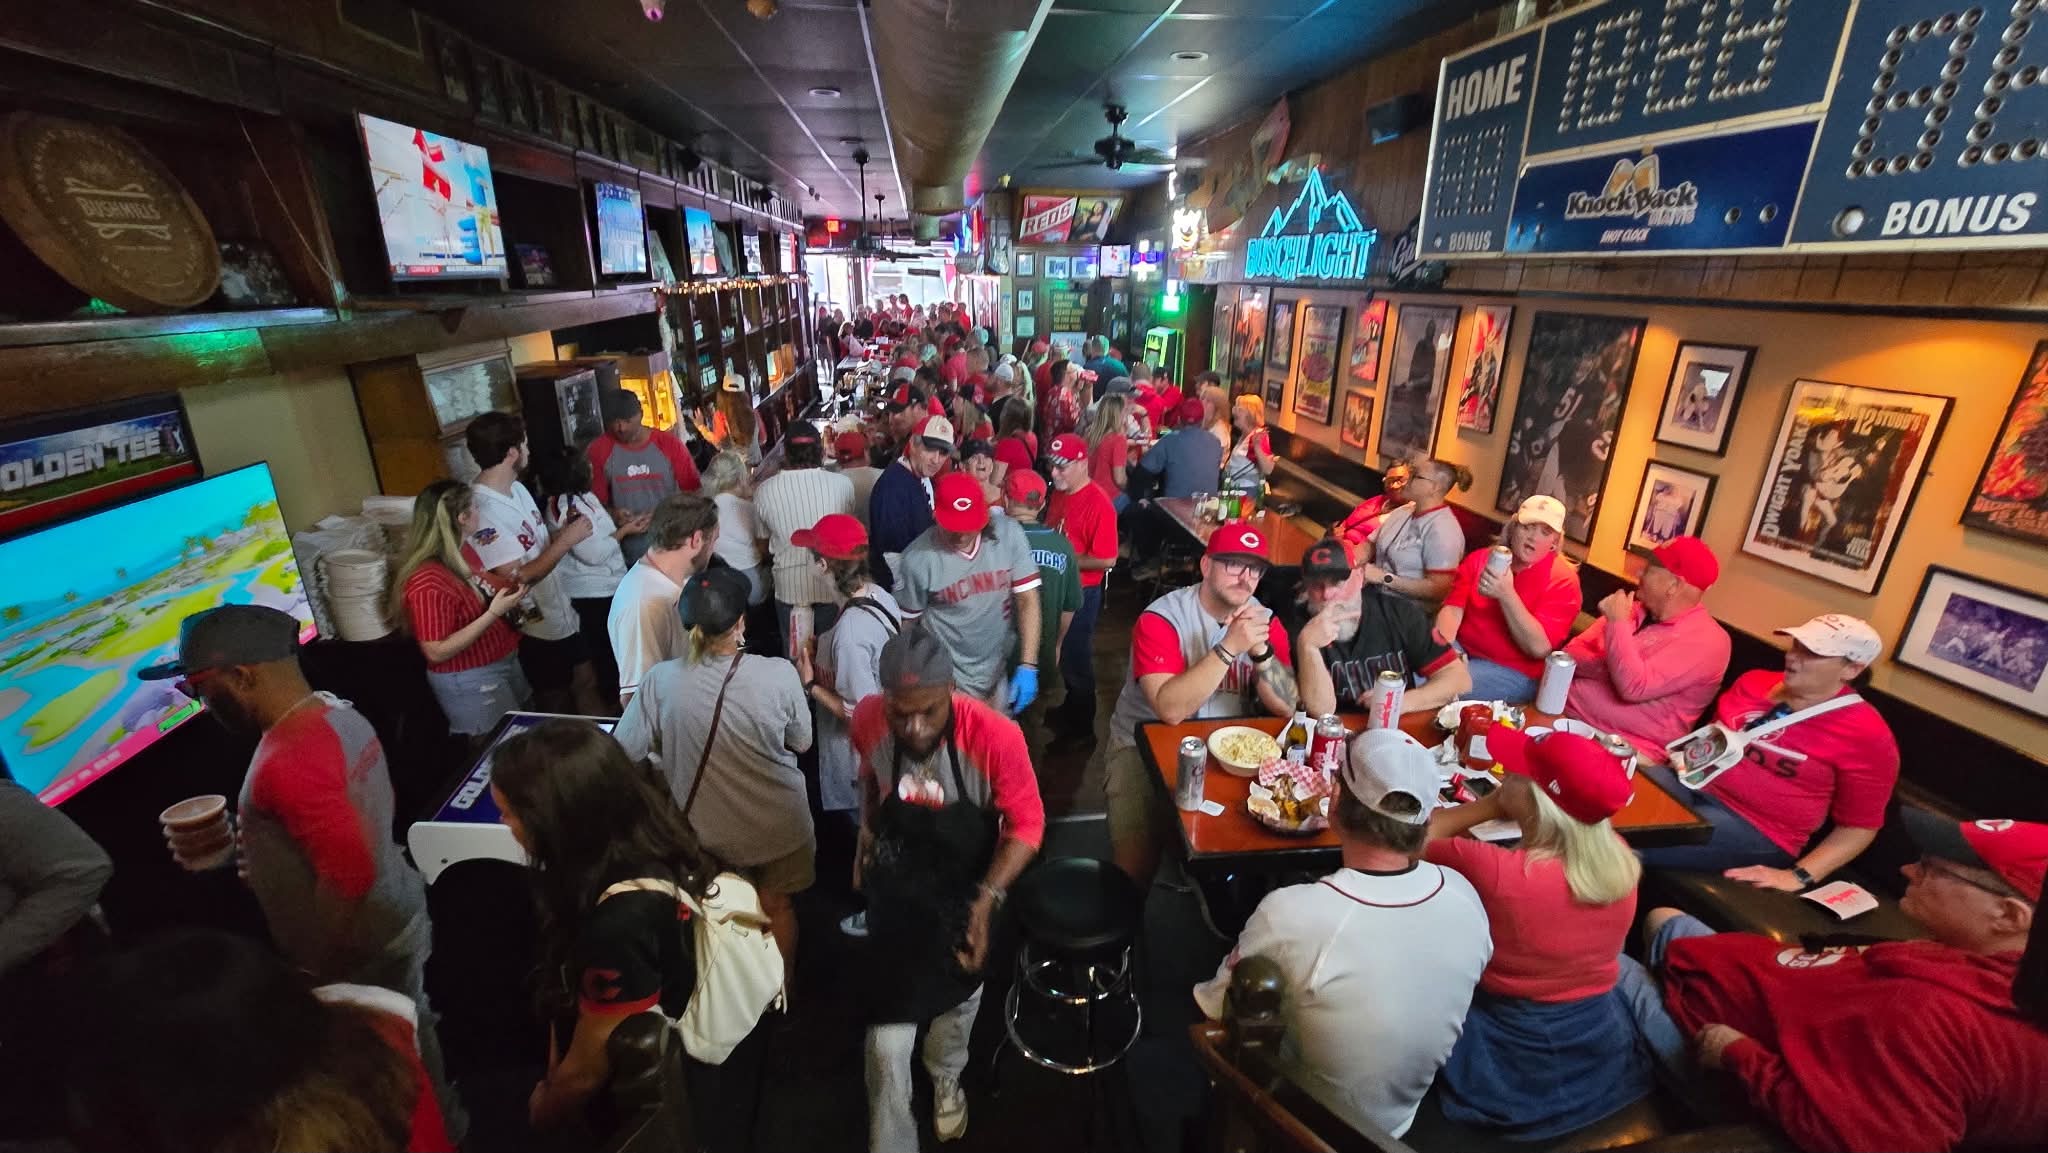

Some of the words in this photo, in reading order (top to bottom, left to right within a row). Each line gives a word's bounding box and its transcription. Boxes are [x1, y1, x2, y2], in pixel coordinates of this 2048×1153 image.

[1446, 54, 1527, 121] HOME
[76, 197, 161, 220] BUSHMILLS
[1023, 202, 1073, 235] REDS
[1881, 192, 2038, 236] BONUS
[1449, 230, 1492, 251] BONUS
[1600, 228, 1623, 244] SHOT
[1622, 227, 1651, 243] CLOCK
[1244, 237, 1299, 281] BUSCH
[1298, 228, 1377, 280] LIGHT
[111, 429, 162, 464] TEE
[1760, 472, 1793, 538] DWIGHT
[1783, 416, 1811, 472] YOAK
